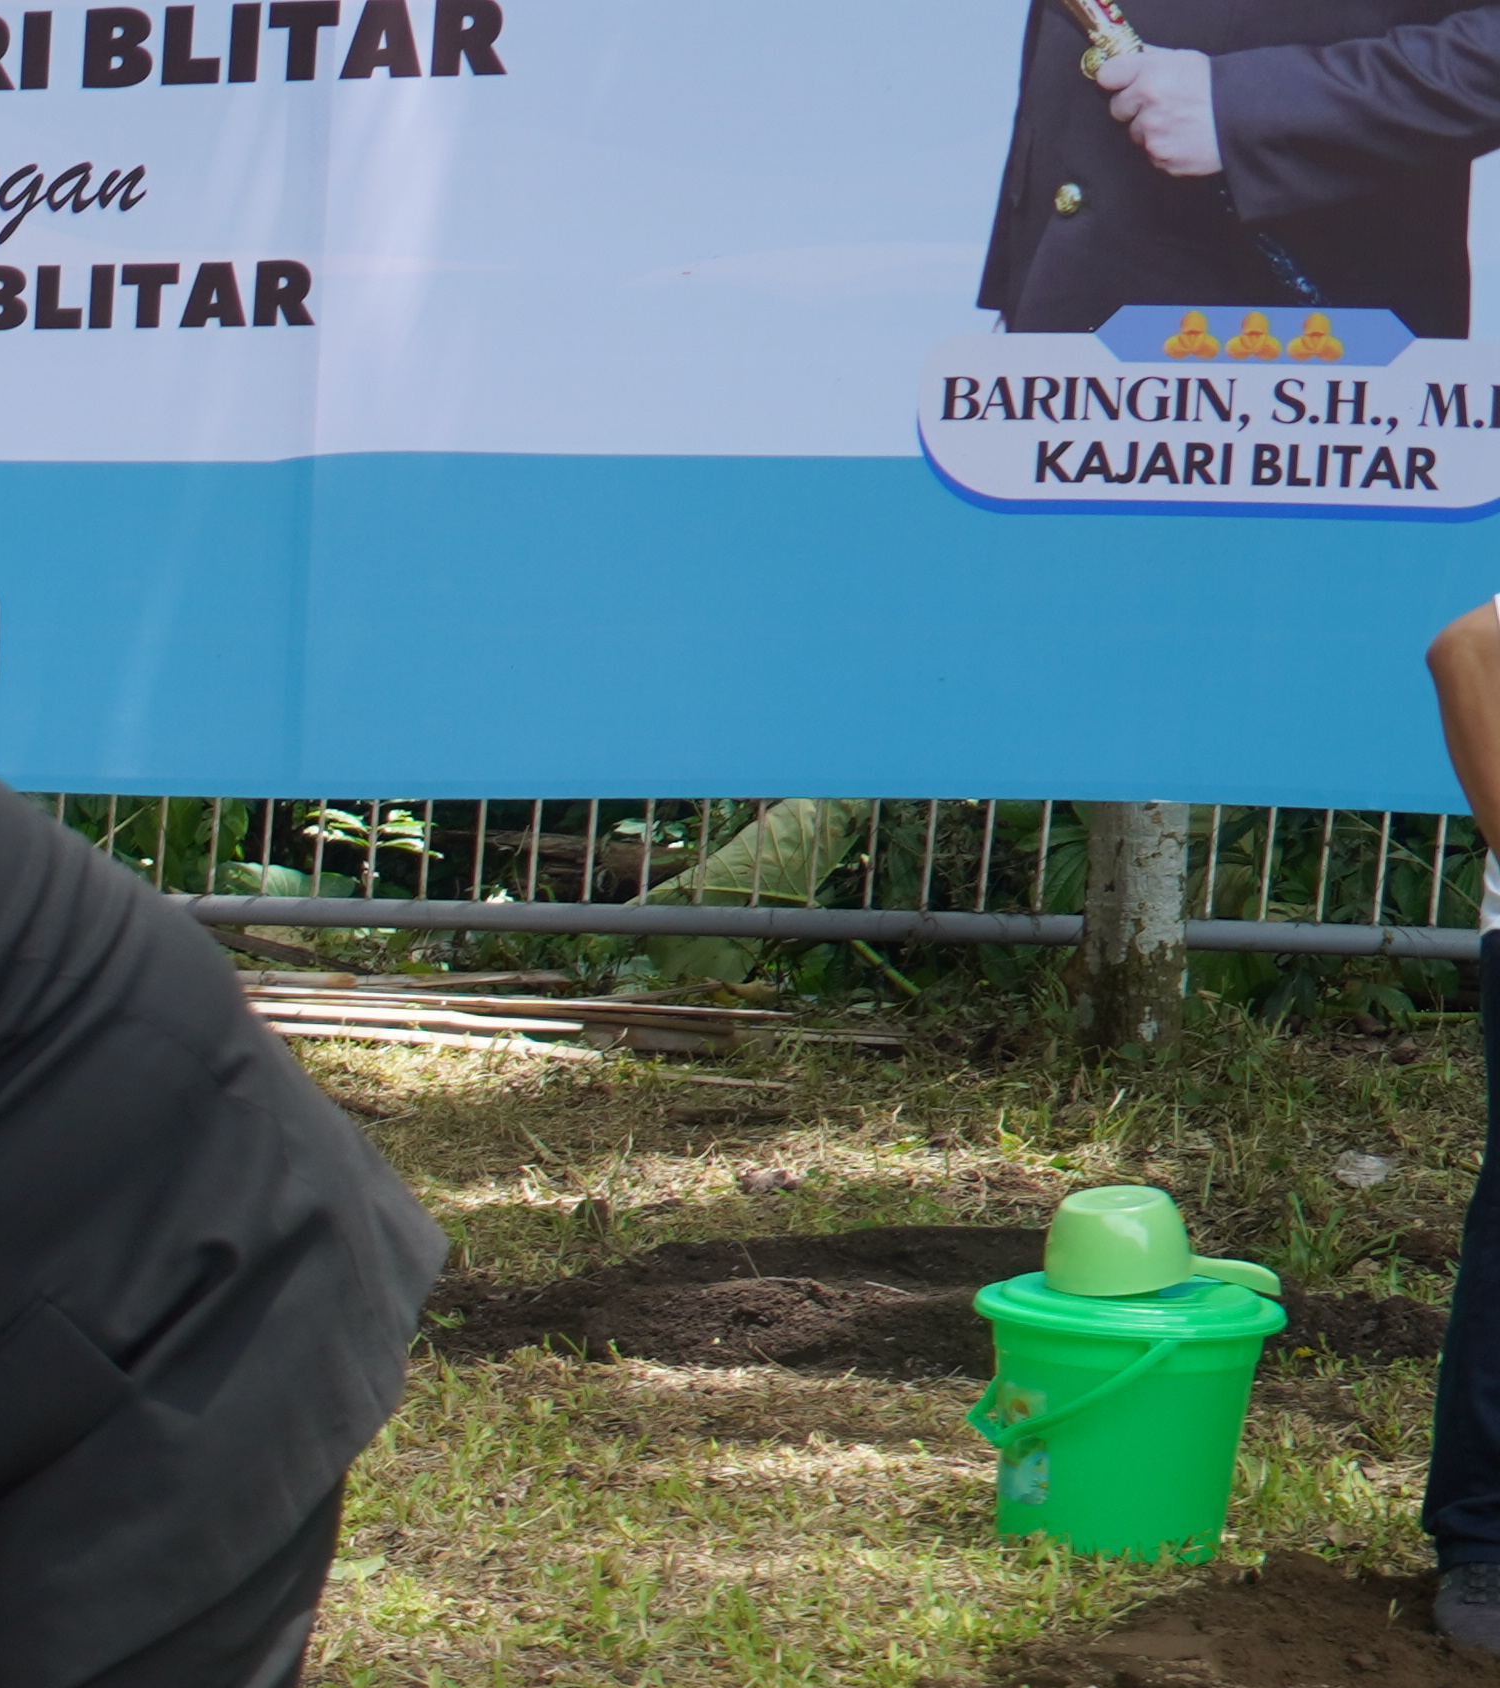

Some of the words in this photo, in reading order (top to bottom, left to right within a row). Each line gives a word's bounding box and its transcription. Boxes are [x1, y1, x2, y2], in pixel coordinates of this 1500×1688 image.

[81, 0, 508, 89] BLITAR
[940, 375, 1252, 431] BARINGIN,
[1271, 378, 1399, 436] S.H.,
[1034, 439, 1234, 486] KAJARI
[1251, 444, 1440, 491] BLITAR
